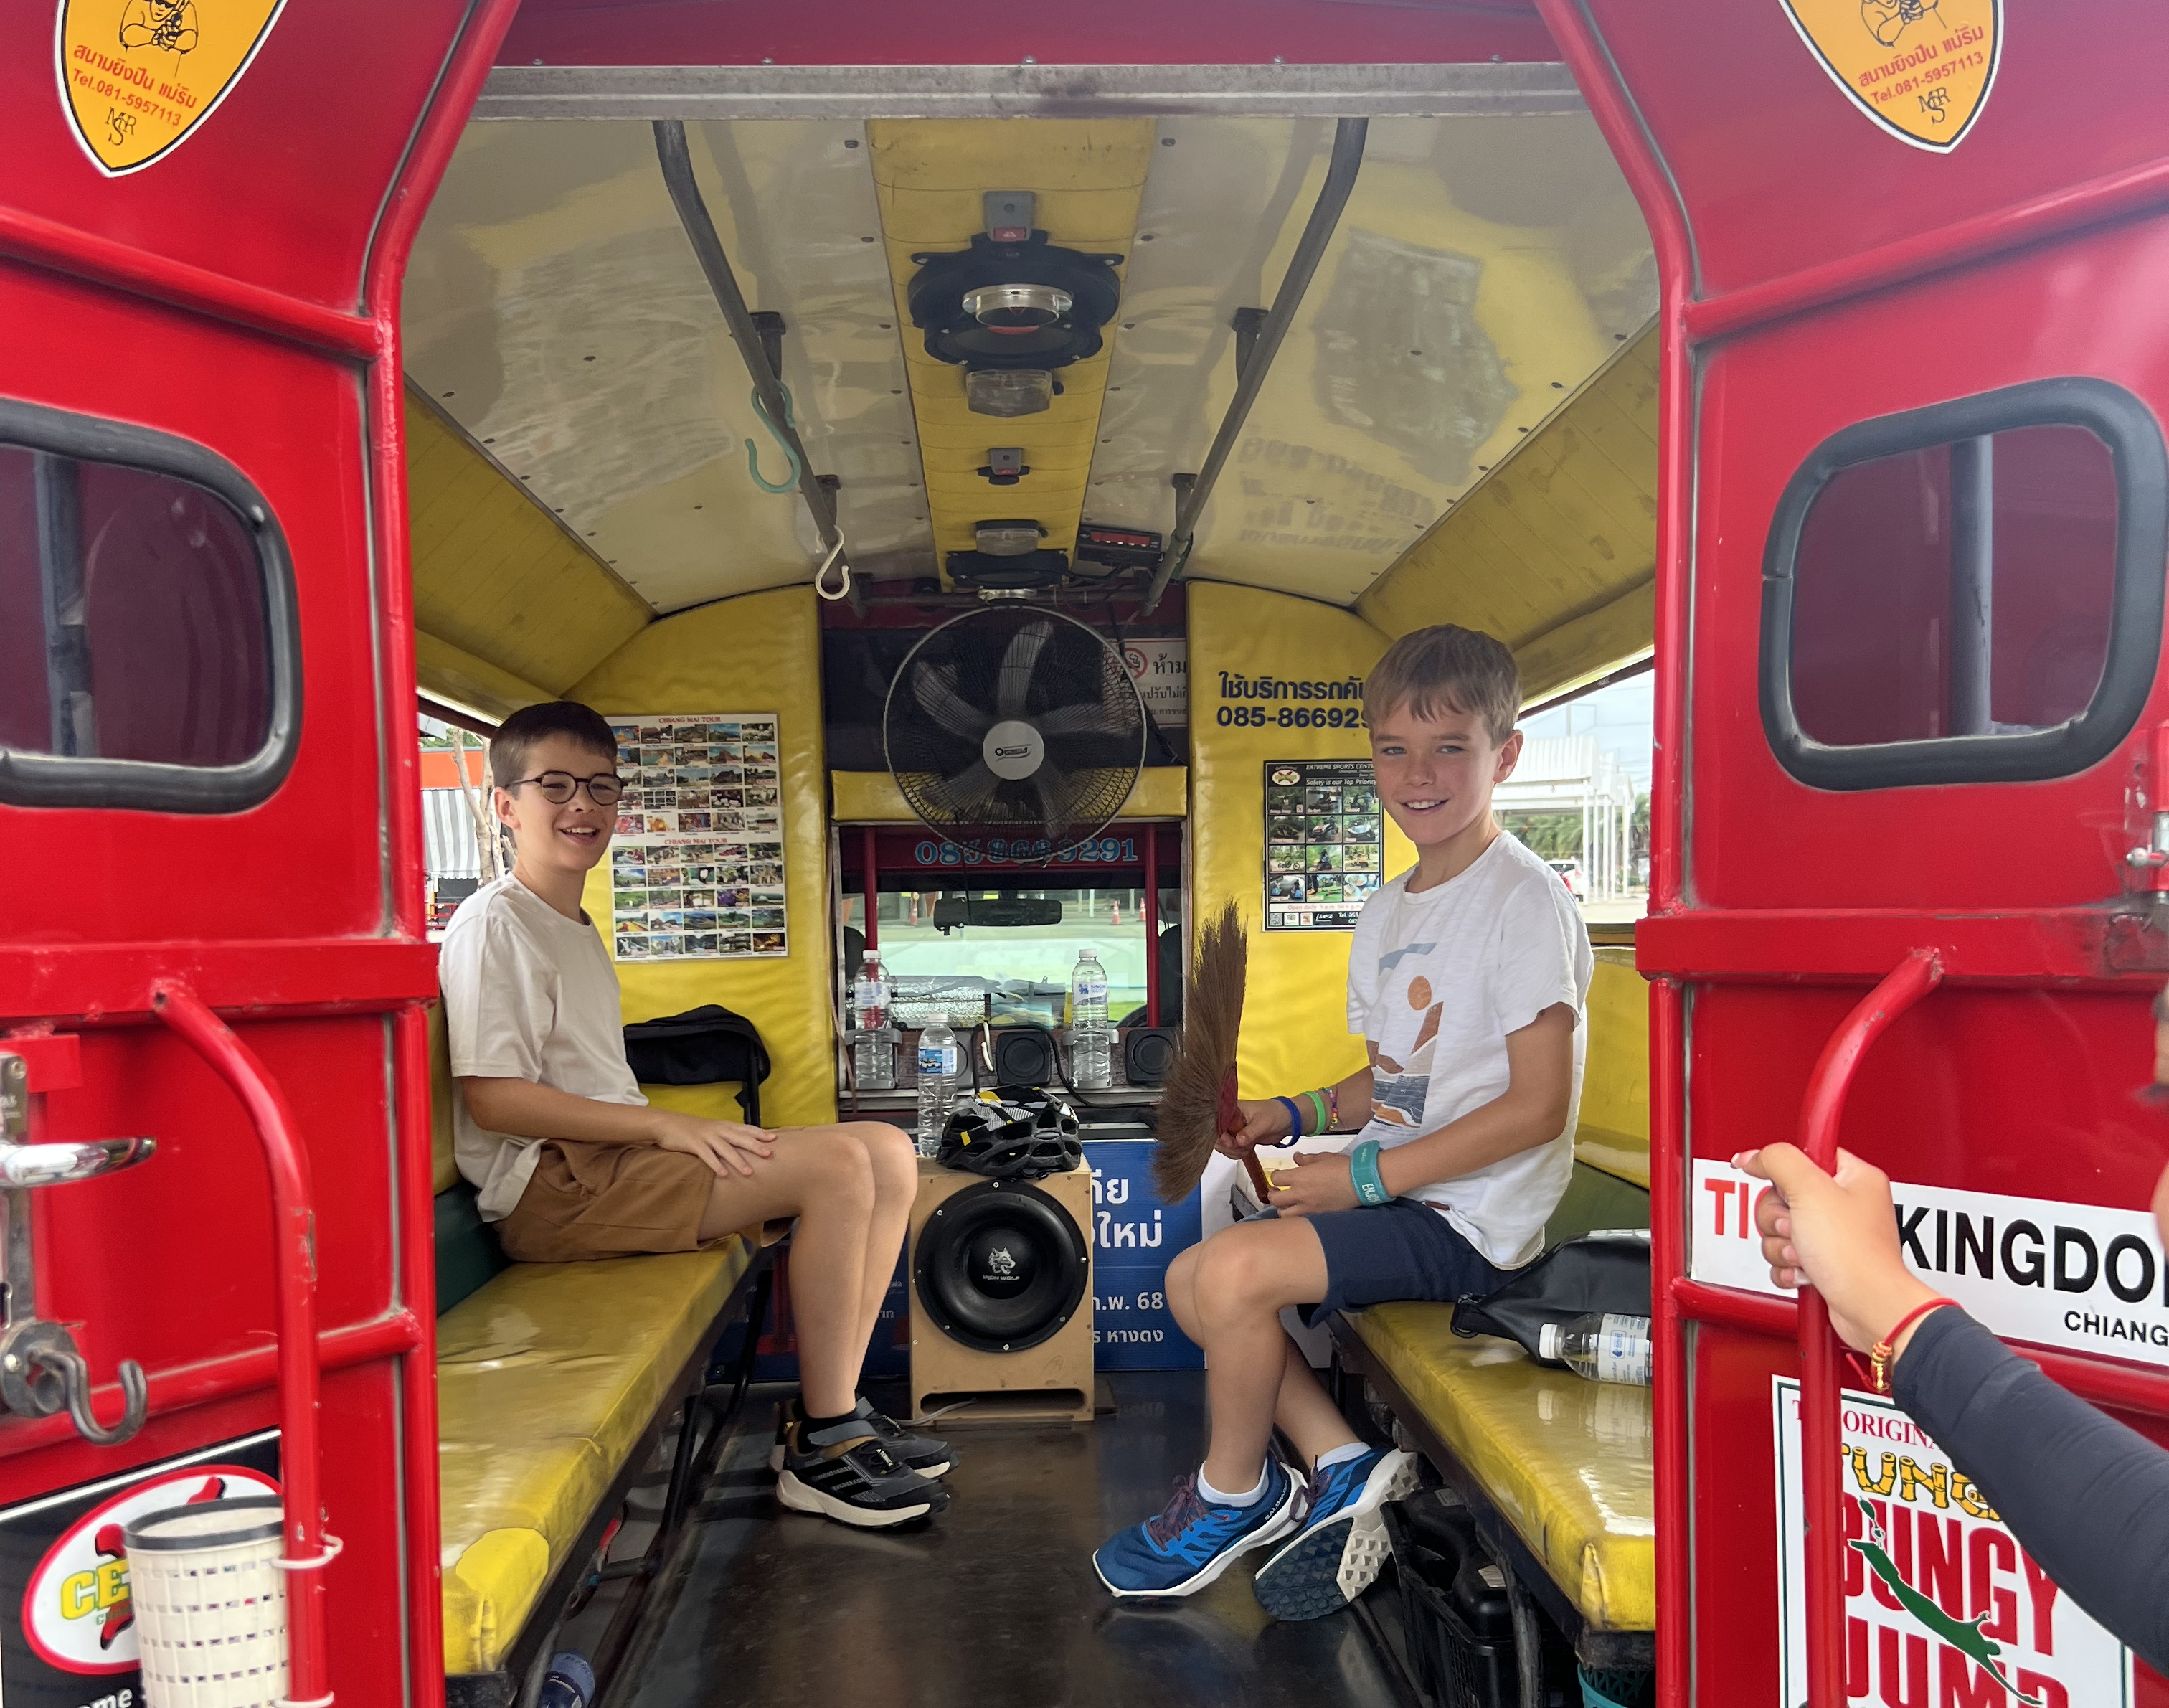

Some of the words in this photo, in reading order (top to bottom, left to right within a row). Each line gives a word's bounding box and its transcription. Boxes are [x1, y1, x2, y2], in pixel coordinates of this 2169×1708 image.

[74, 44, 155, 90] สนามยิงปืน
[159, 82, 197, 108] แม่ริม
[1858, 43, 1938, 88] สนามยิงปืน
[1942, 26, 1984, 55] แม่ริม
[73, 68, 181, 126] Tel.081-5957113
[1871, 51, 1983, 105] Tel.081-5957113
[1217, 707, 1369, 729] 085-86692
[1092, 1209, 1162, 1247] ใหม่
[1894, 1204, 2169, 1308] KINGDO
[1138, 1292, 1163, 1311] 68
[1107, 1330, 1163, 1343] หางดง
[2064, 1311, 2169, 1347] CHIANG
[1843, 1410, 1935, 1449] ORIGIN
